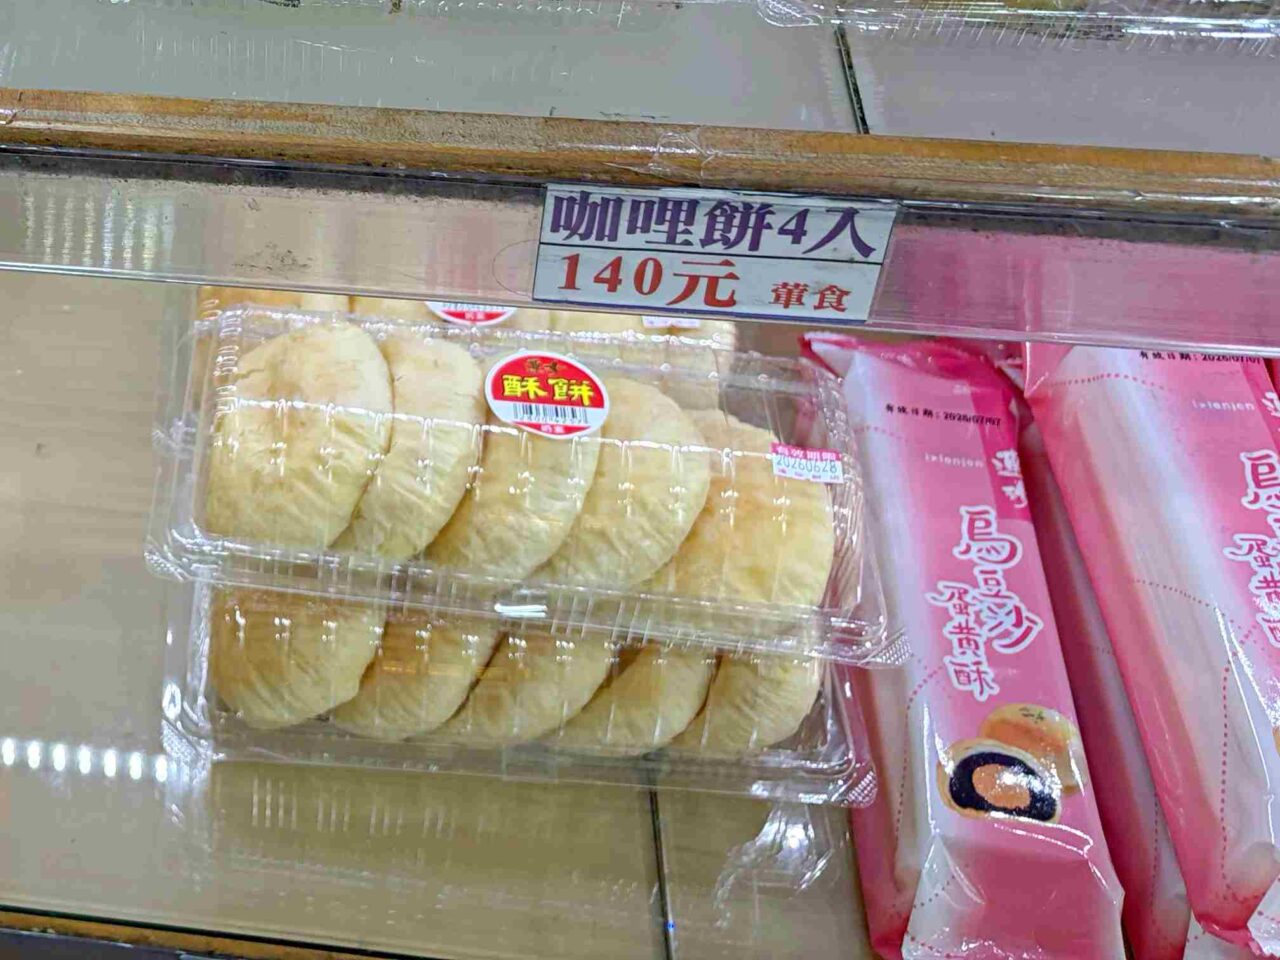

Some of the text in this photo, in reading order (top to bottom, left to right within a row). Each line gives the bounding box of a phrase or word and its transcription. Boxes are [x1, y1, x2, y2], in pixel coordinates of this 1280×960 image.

[550, 190, 876, 259] 咖哩餅4入
[558, 253, 851, 312] 140元 葷食
[502, 374, 594, 406] 酥餅
[776, 454, 838, 474] 20260628
